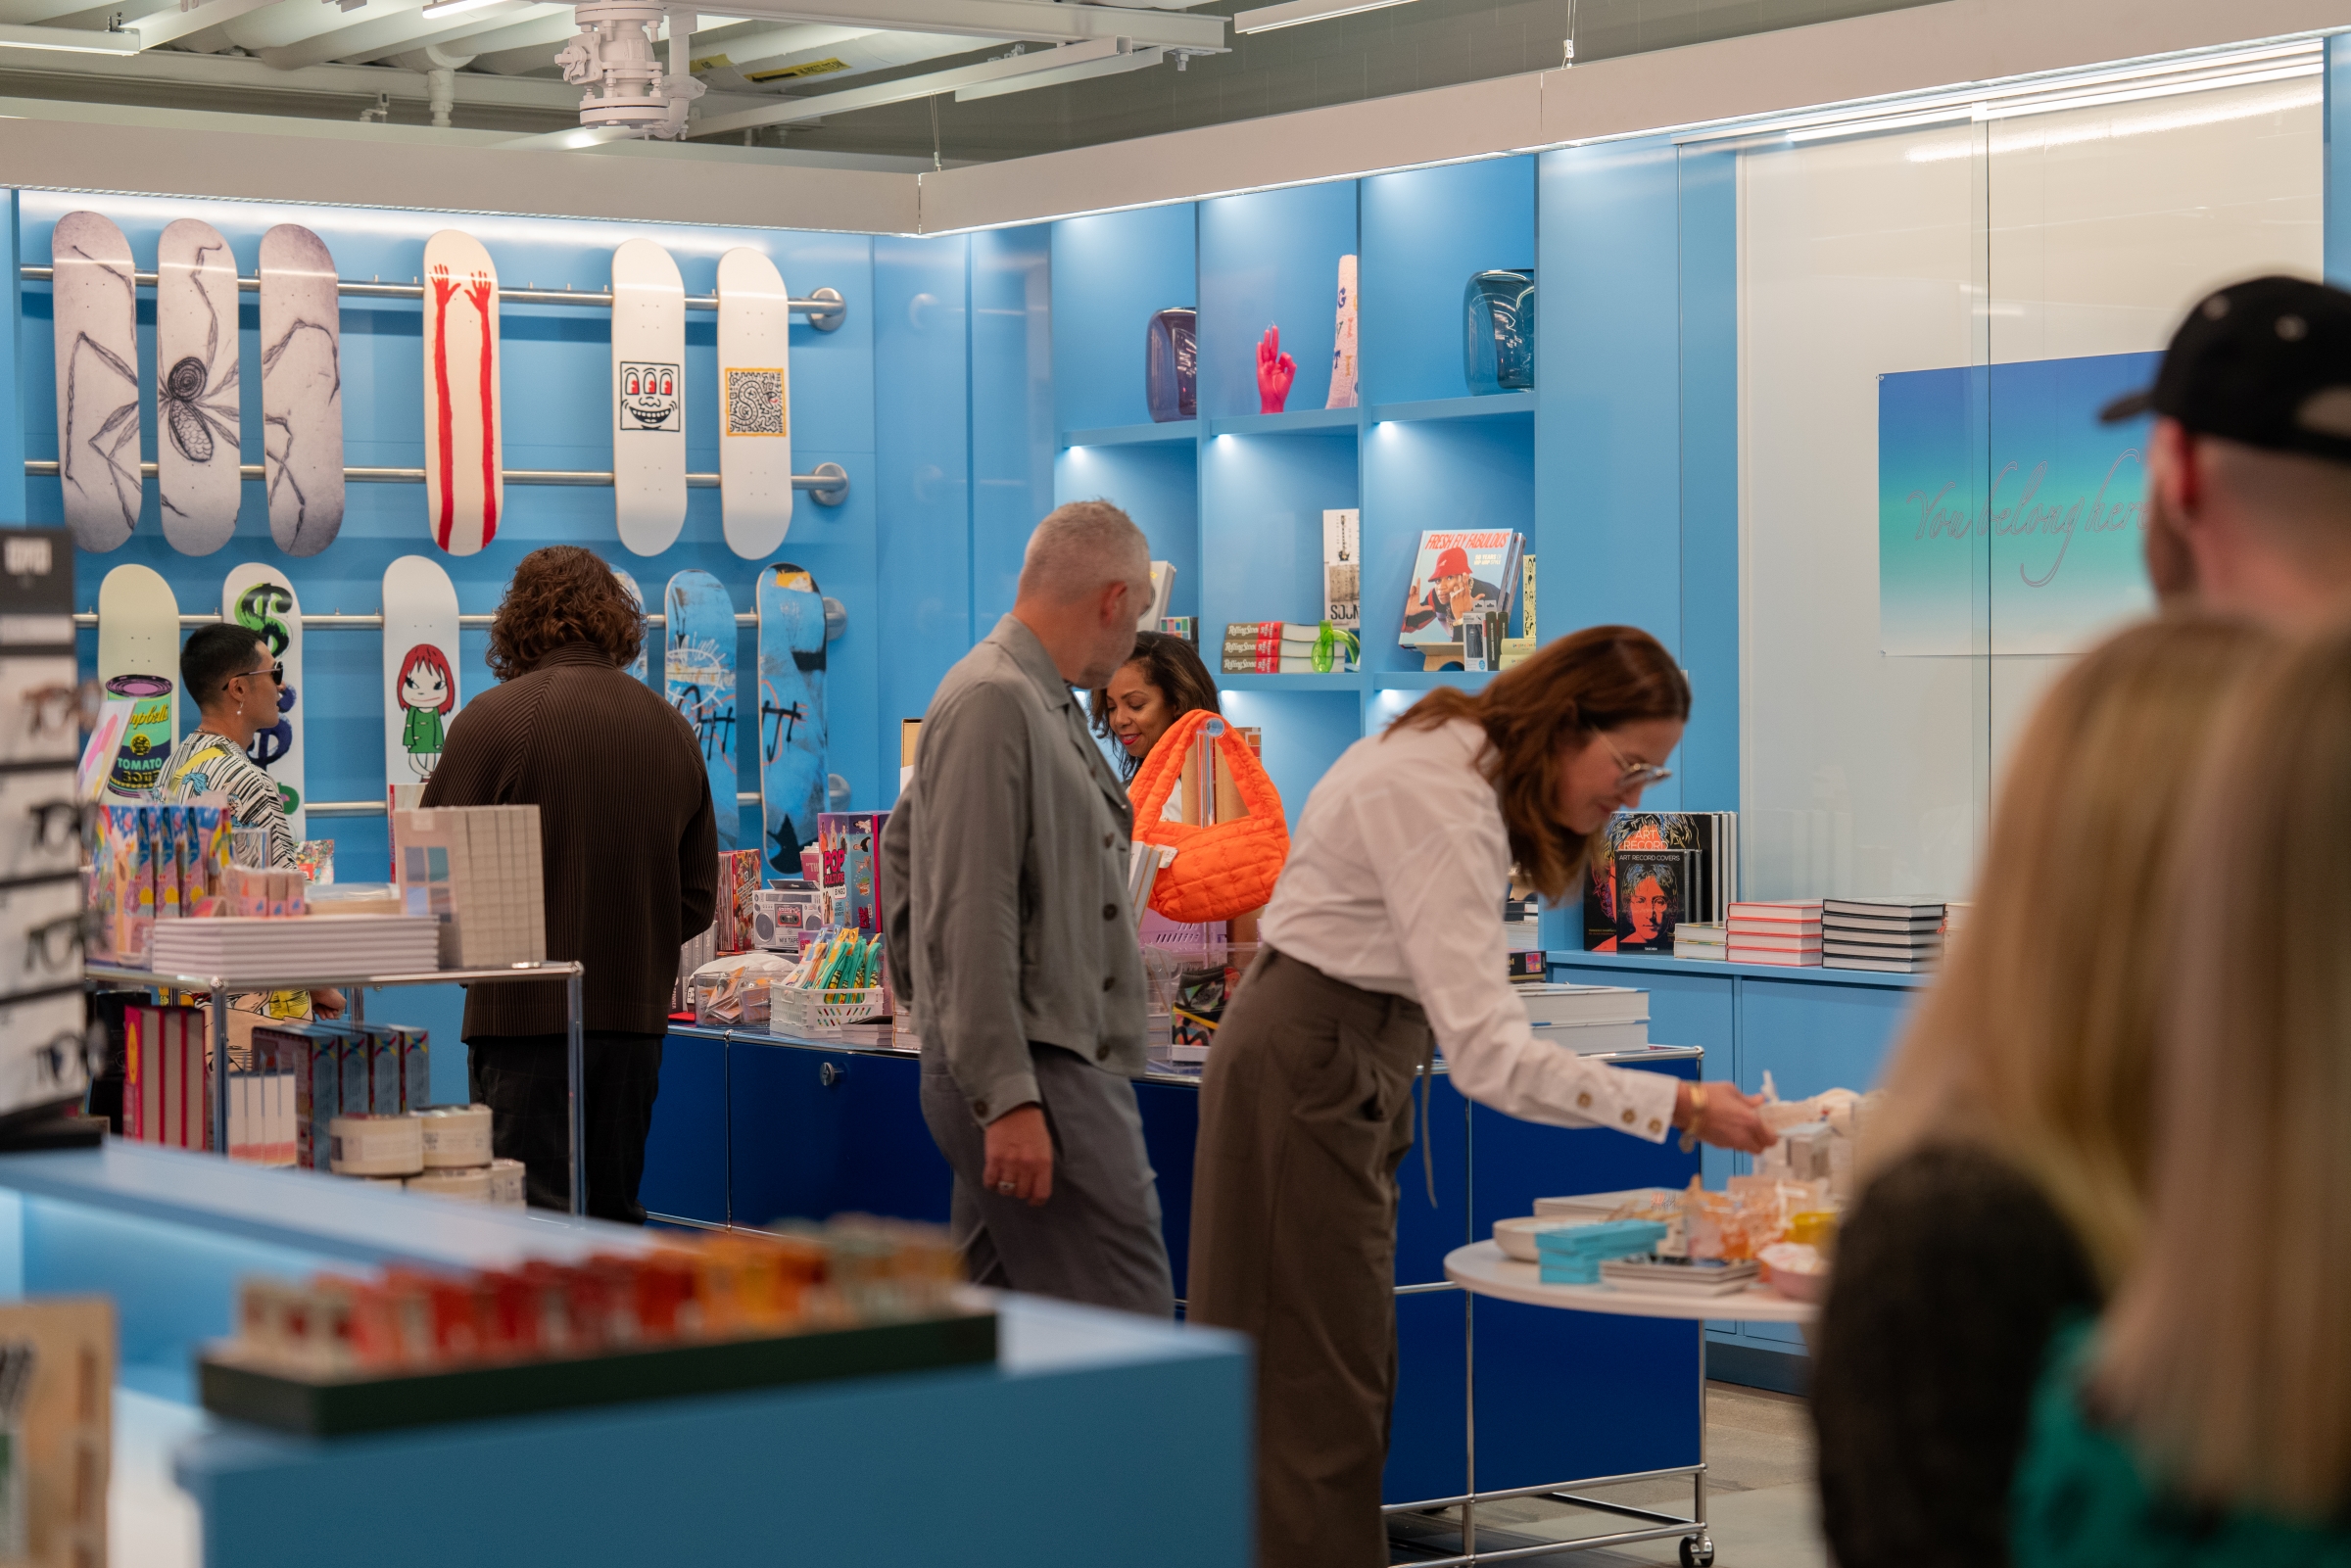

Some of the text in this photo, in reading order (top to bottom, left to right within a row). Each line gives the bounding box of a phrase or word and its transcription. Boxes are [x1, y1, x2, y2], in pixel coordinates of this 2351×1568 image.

[1906, 481, 1973, 541] You
[1977, 460, 2085, 588] belong
[1424, 532, 1511, 549] FRESH FLY FABULOUS
[118, 757, 163, 771] TOMATO
[1635, 831, 1656, 839] ART
[1623, 841, 1668, 850] RECORD
[824, 849, 845, 874] POP
[824, 871, 845, 886] CULTURE
[835, 883, 846, 895] BINGO
